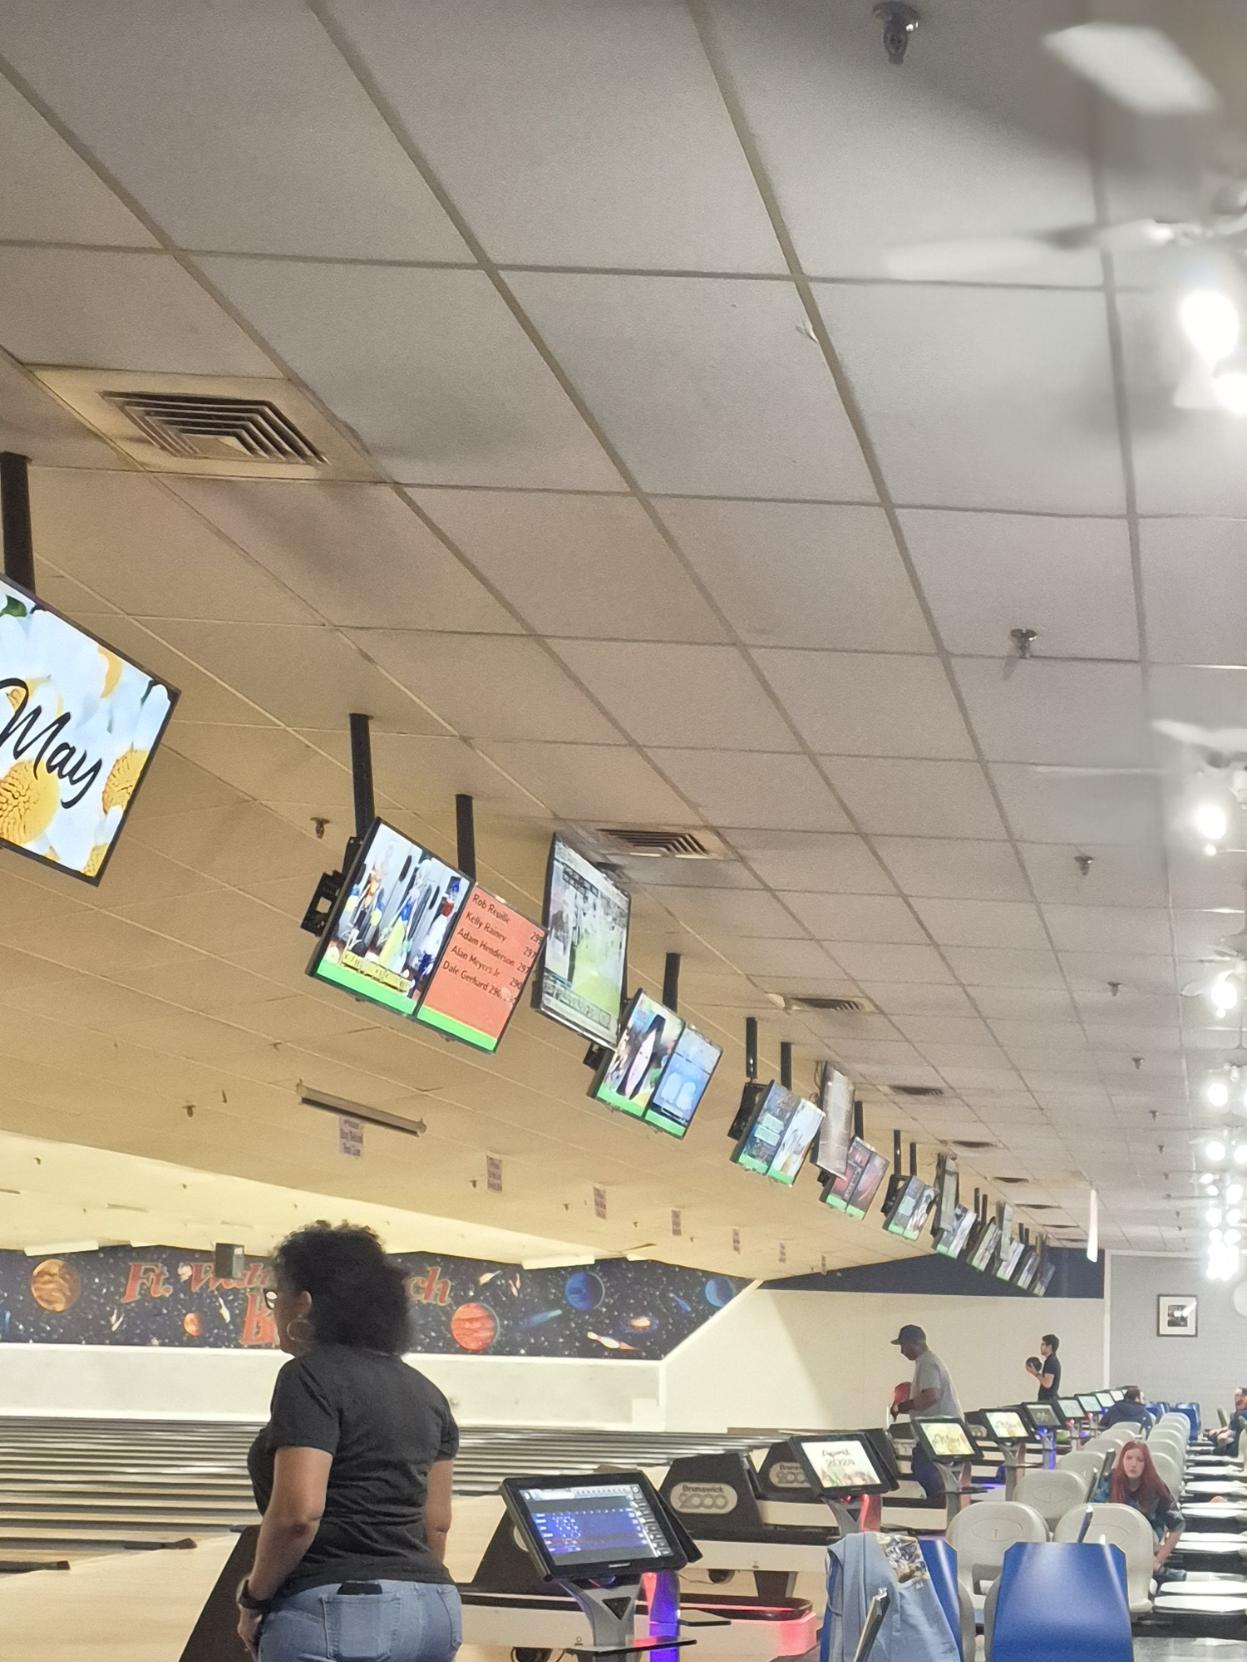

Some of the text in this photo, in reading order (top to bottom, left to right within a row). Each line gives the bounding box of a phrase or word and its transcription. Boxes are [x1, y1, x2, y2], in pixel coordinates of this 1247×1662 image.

[0, 678, 103, 809] May
[472, 894, 487, 909] Rob
[466, 911, 484, 930] Kelly
[458, 928, 479, 946] Adam
[451, 946, 468, 960] Alan
[442, 960, 459, 976] Dale
[679, 1493, 728, 1509] 2000
